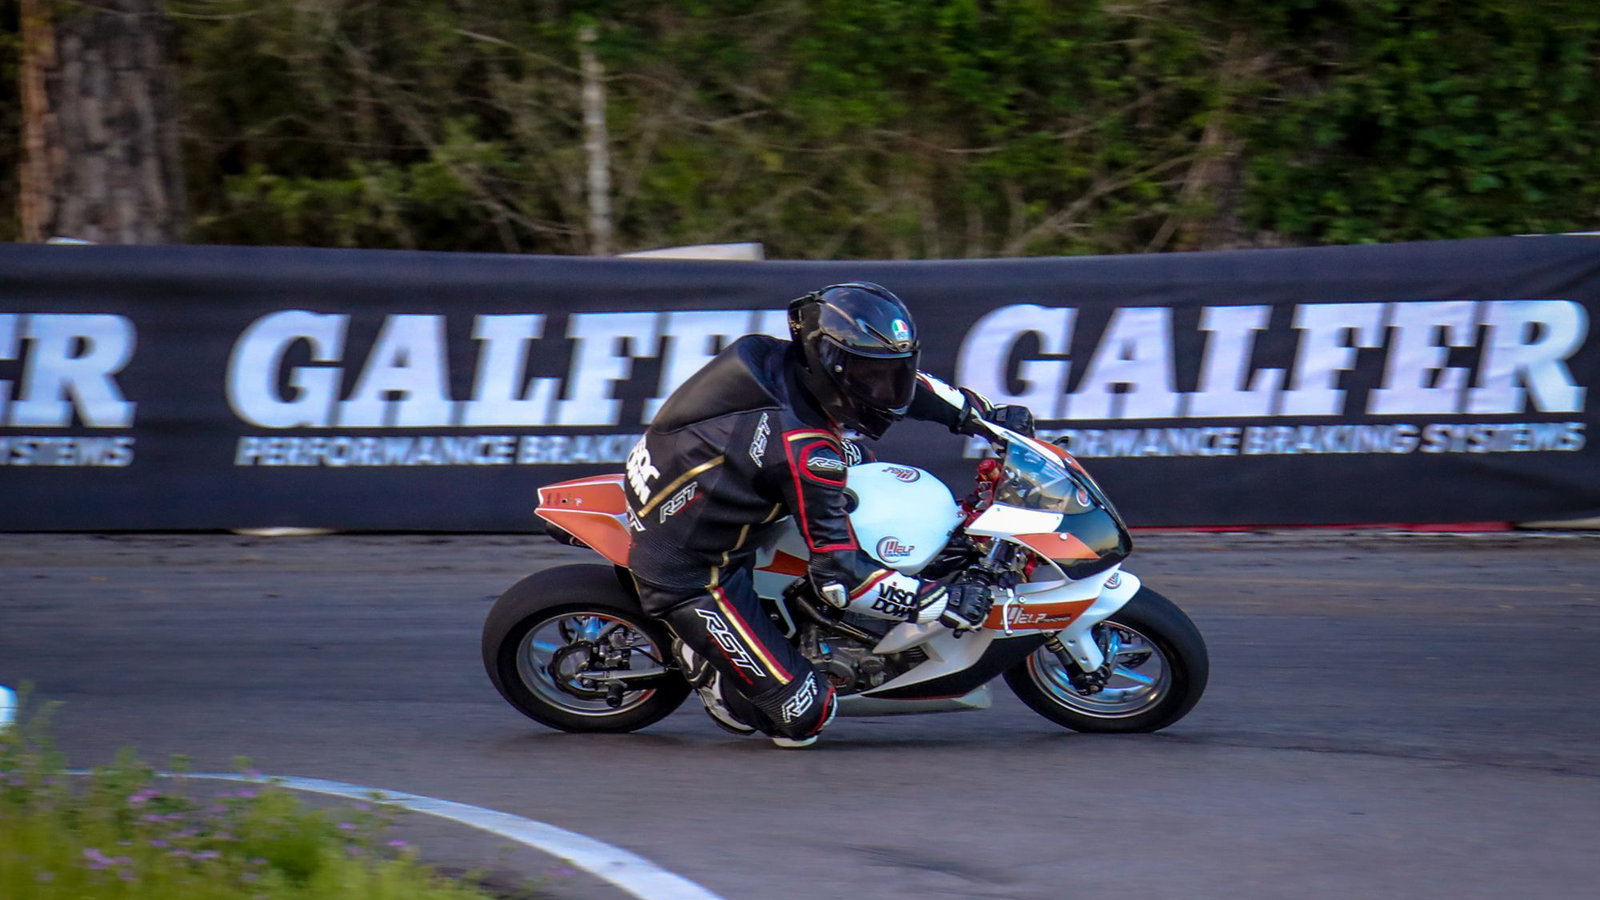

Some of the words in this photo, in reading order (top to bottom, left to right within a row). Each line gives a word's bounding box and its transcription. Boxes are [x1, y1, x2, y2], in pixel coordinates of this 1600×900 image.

[0, 313, 137, 428] R
[955, 300, 1590, 420] GALFER
[234, 436, 516, 467] PERFORMANCE
[749, 411, 771, 468] RST
[1241, 424, 1420, 455] BRAKING
[1419, 422, 1587, 453] SYSTEMS
[660, 481, 699, 524] RST
[694, 608, 767, 678] RST
[781, 671, 818, 723] RST
